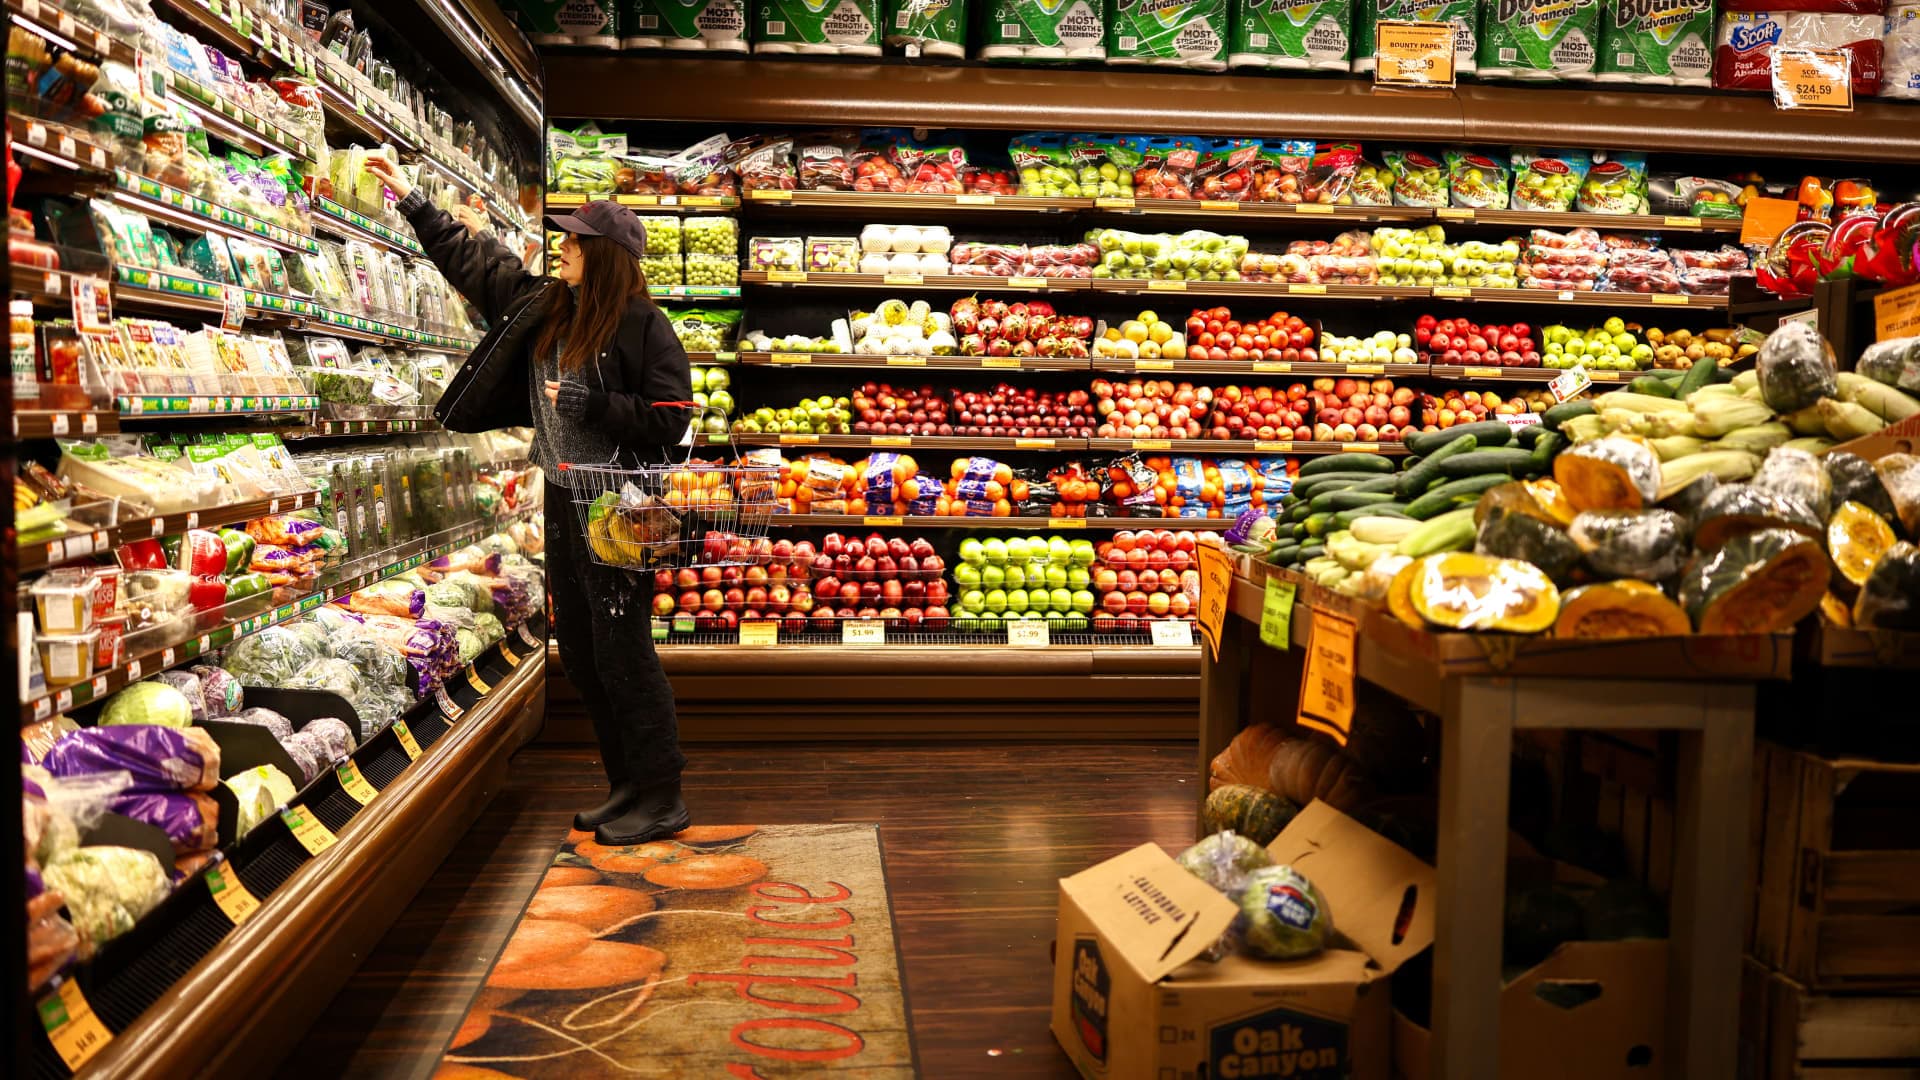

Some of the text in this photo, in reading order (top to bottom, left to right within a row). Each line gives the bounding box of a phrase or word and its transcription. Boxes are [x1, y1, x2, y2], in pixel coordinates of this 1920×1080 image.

[832, 13, 862, 23] MOST
[1066, 16, 1095, 25] MOST
[1518, 4, 1576, 27] Advanced
[1636, 10, 1694, 33] Advanced
[1313, 28, 1341, 39] MOST
[1737, 22, 1775, 49] Scott
[1561, 41, 1589, 51] MOST
[1679, 47, 1706, 57] MOST
[1734, 62, 1754, 70] Fast
[1796, 84, 1832, 95] $24.59
[1122, 891, 1162, 925] LETTUCE
[1134, 876, 1186, 923] CALIFORNIA
[1233, 1023, 1303, 1051] Oak
[1220, 1048, 1337, 1080] Canyon
